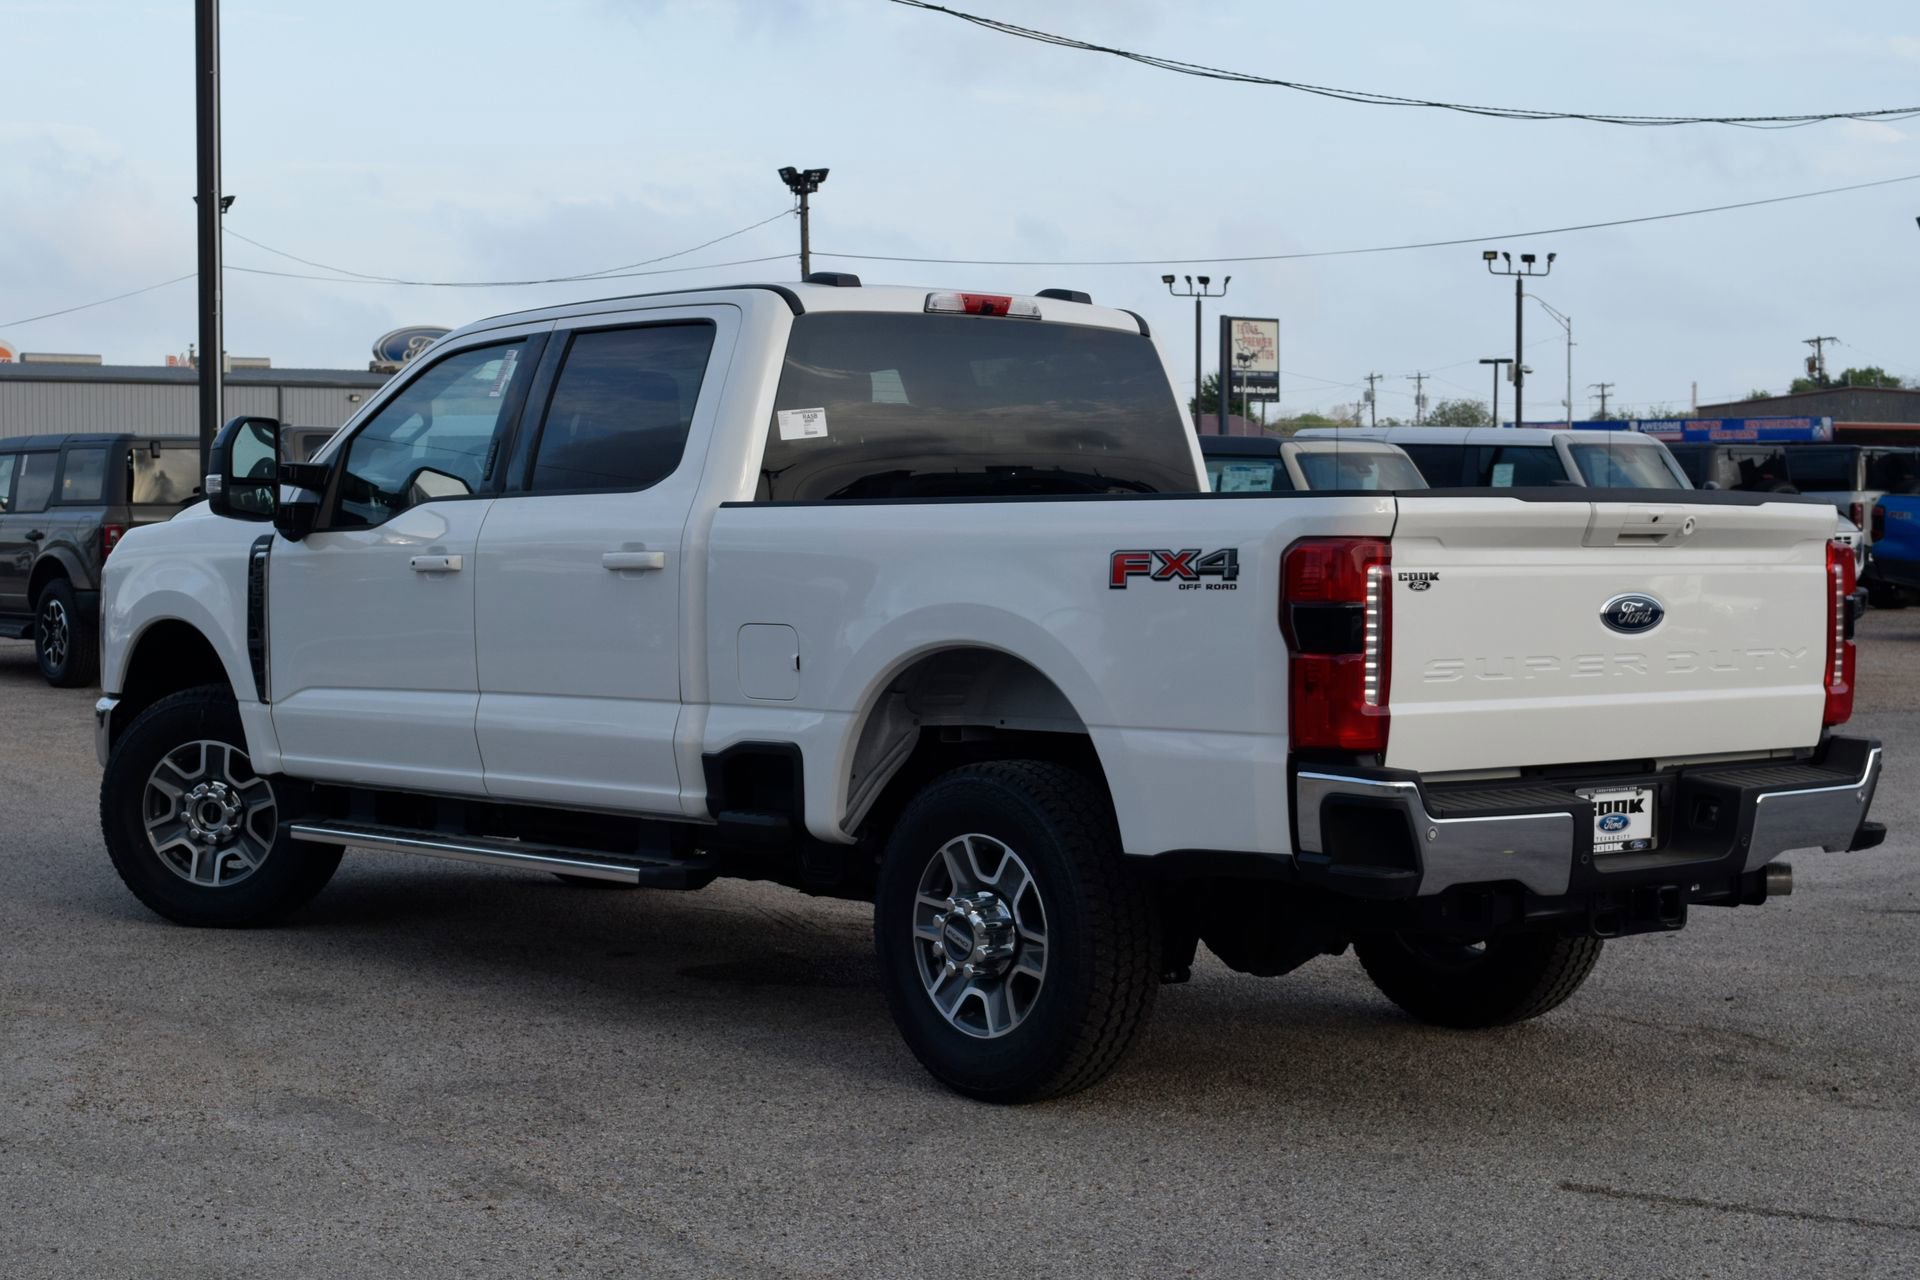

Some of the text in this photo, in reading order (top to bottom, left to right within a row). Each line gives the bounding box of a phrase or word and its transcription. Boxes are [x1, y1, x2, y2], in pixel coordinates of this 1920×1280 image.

[1243, 336, 1273, 348] PREMIER
[1640, 421, 1681, 432] AWESOME
[1109, 548, 1239, 589] FX4
[1398, 572, 1440, 581] COOK
[1618, 601, 1653, 624] Ford
[1424, 647, 1808, 683] SUPER DUTY
[1594, 798, 1644, 816] OOK
[1603, 816, 1624, 830] Ford
[947, 929, 969, 948] FORD
